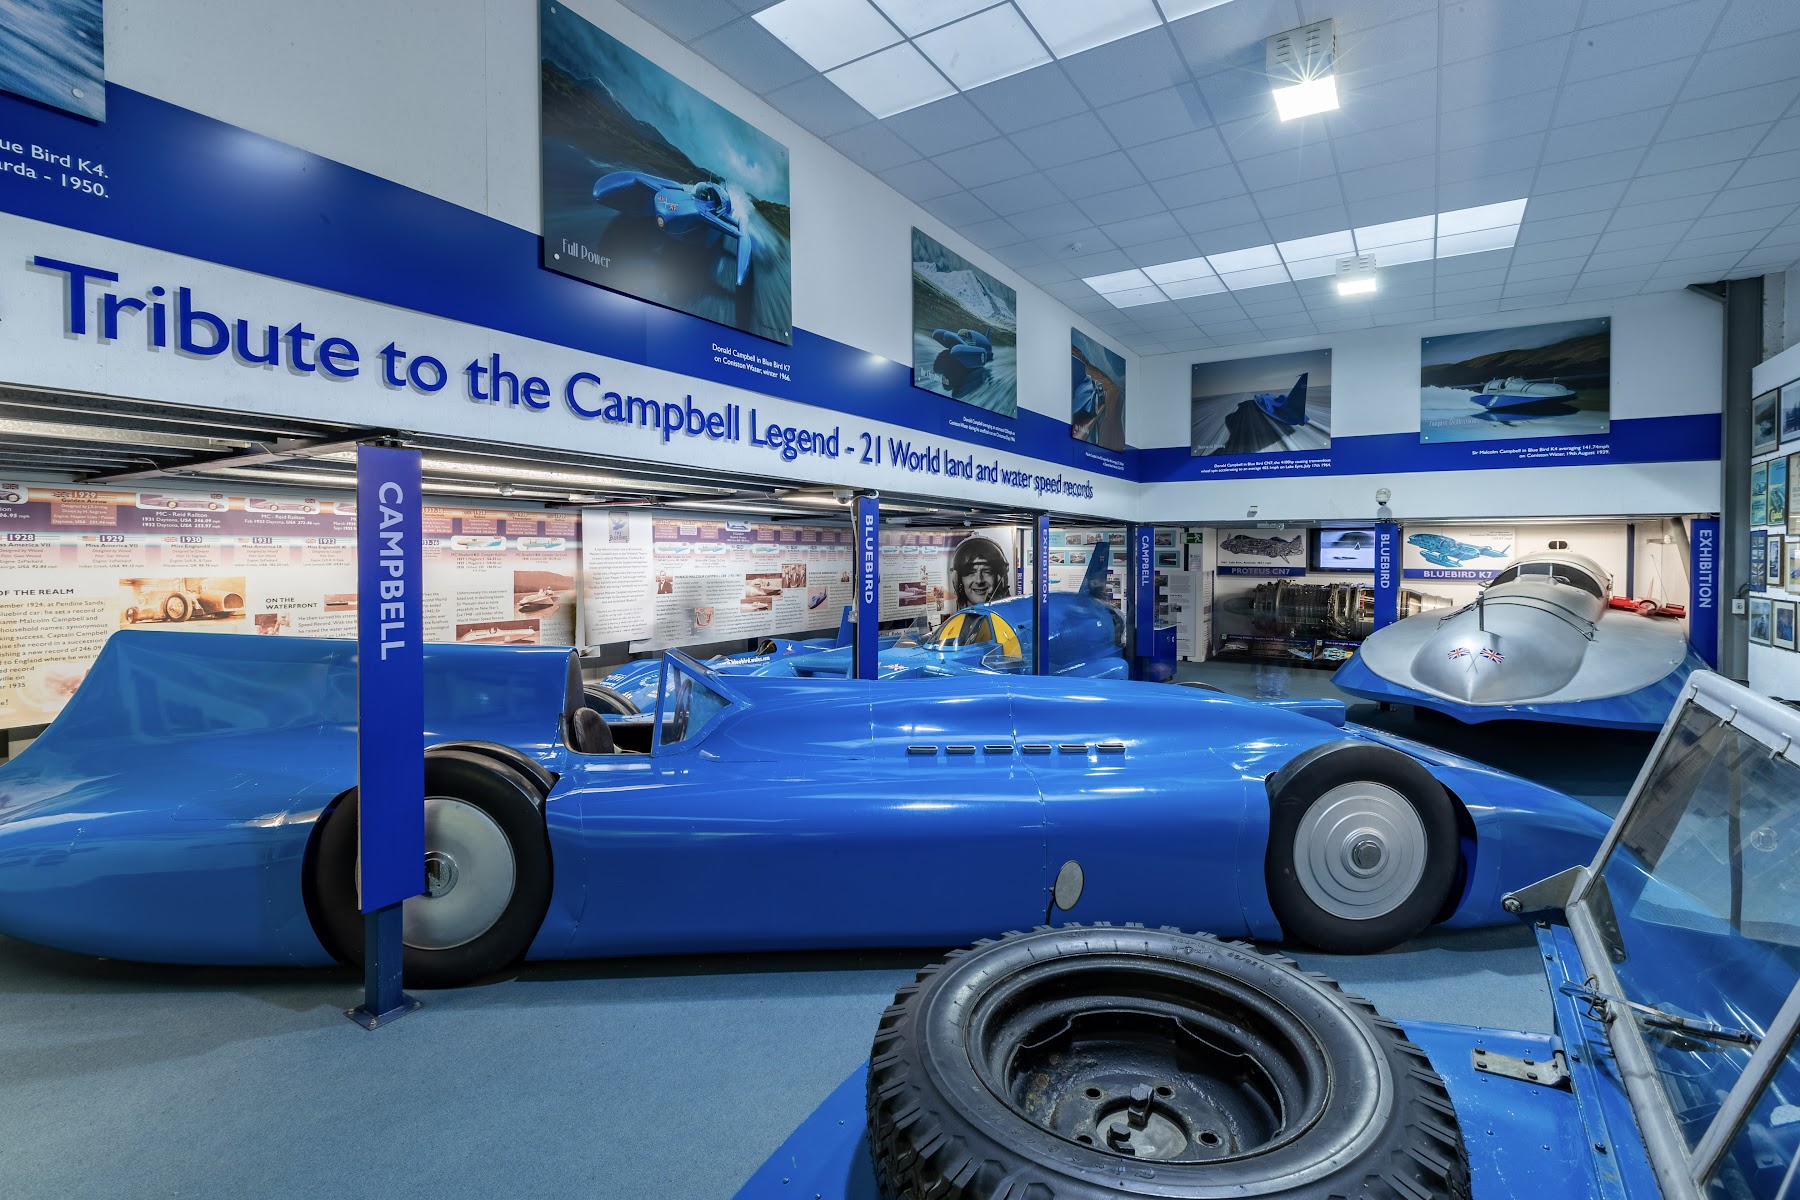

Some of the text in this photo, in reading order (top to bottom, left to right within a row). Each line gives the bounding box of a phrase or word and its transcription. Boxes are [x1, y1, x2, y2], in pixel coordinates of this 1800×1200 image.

[31, 144, 71, 168] Bird
[78, 158, 109, 179] K4.
[62, 173, 109, 199] 1950.
[562, 238, 611, 268] Full Power
[34, 255, 359, 377] Tribute
[380, 341, 447, 392] to
[466, 353, 551, 409] the
[566, 372, 740, 441] Campbell
[751, 408, 840, 460] Legend
[861, 431, 881, 463] 21
[889, 438, 940, 473] World
[945, 451, 973, 479] land
[977, 460, 997, 483] and
[1001, 468, 1032, 488] water
[1035, 474, 1062, 497] speed
[1064, 479, 1093, 499] records
[712, 343, 732, 355] Donald
[732, 349, 756, 362] Campbell
[774, 361, 783, 370] Bird
[378, 481, 405, 661] CAMPBELL
[865, 514, 874, 604] BLUEBIRD
[1142, 535, 1150, 587] CAMPBELL
[1380, 534, 1390, 588] BLUEBIRD
[1424, 570, 1476, 578] BLUEBIRD
[1698, 529, 1713, 608] EXHIBITION
